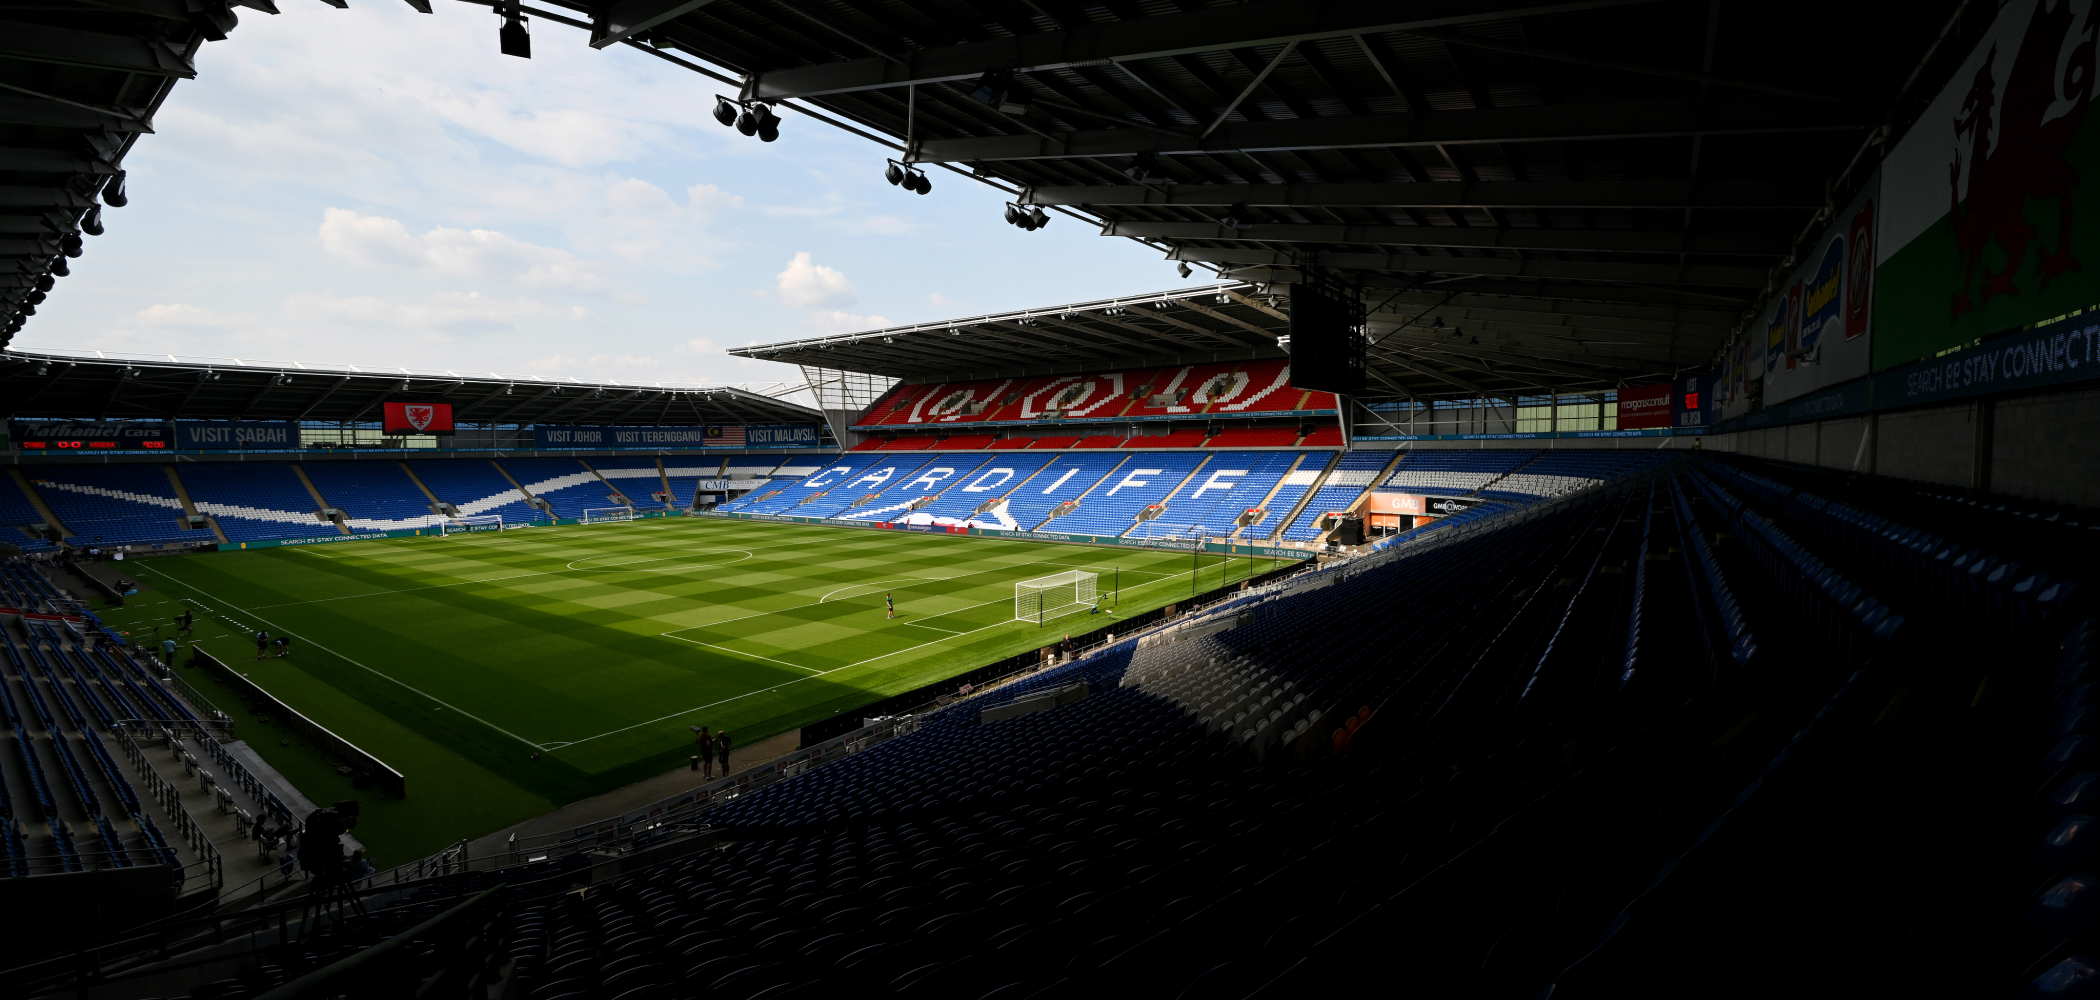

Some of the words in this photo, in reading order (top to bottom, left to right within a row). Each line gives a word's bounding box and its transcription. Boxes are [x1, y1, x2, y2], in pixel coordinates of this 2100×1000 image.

[1907, 365, 1942, 396] SEARCH
[1963, 350, 2000, 387] STAY
[2002, 325, 2100, 379] CONNECT
[24, 424, 124, 437] Nathaniel
[124, 429, 162, 437] cars
[190, 427, 231, 442] VISIT
[235, 428, 287, 443] SABAH
[546, 430, 572, 442] VISIT
[574, 431, 602, 442] JOHOR
[616, 432, 639, 442] VISIT
[641, 430, 700, 442] TERENGGANU
[748, 430, 773, 442] VISIT
[774, 428, 816, 442] MALAYSIA
[706, 480, 729, 490] CMB
[803, 466, 1250, 500] CARDIFF
[1392, 498, 1419, 510] GMB
